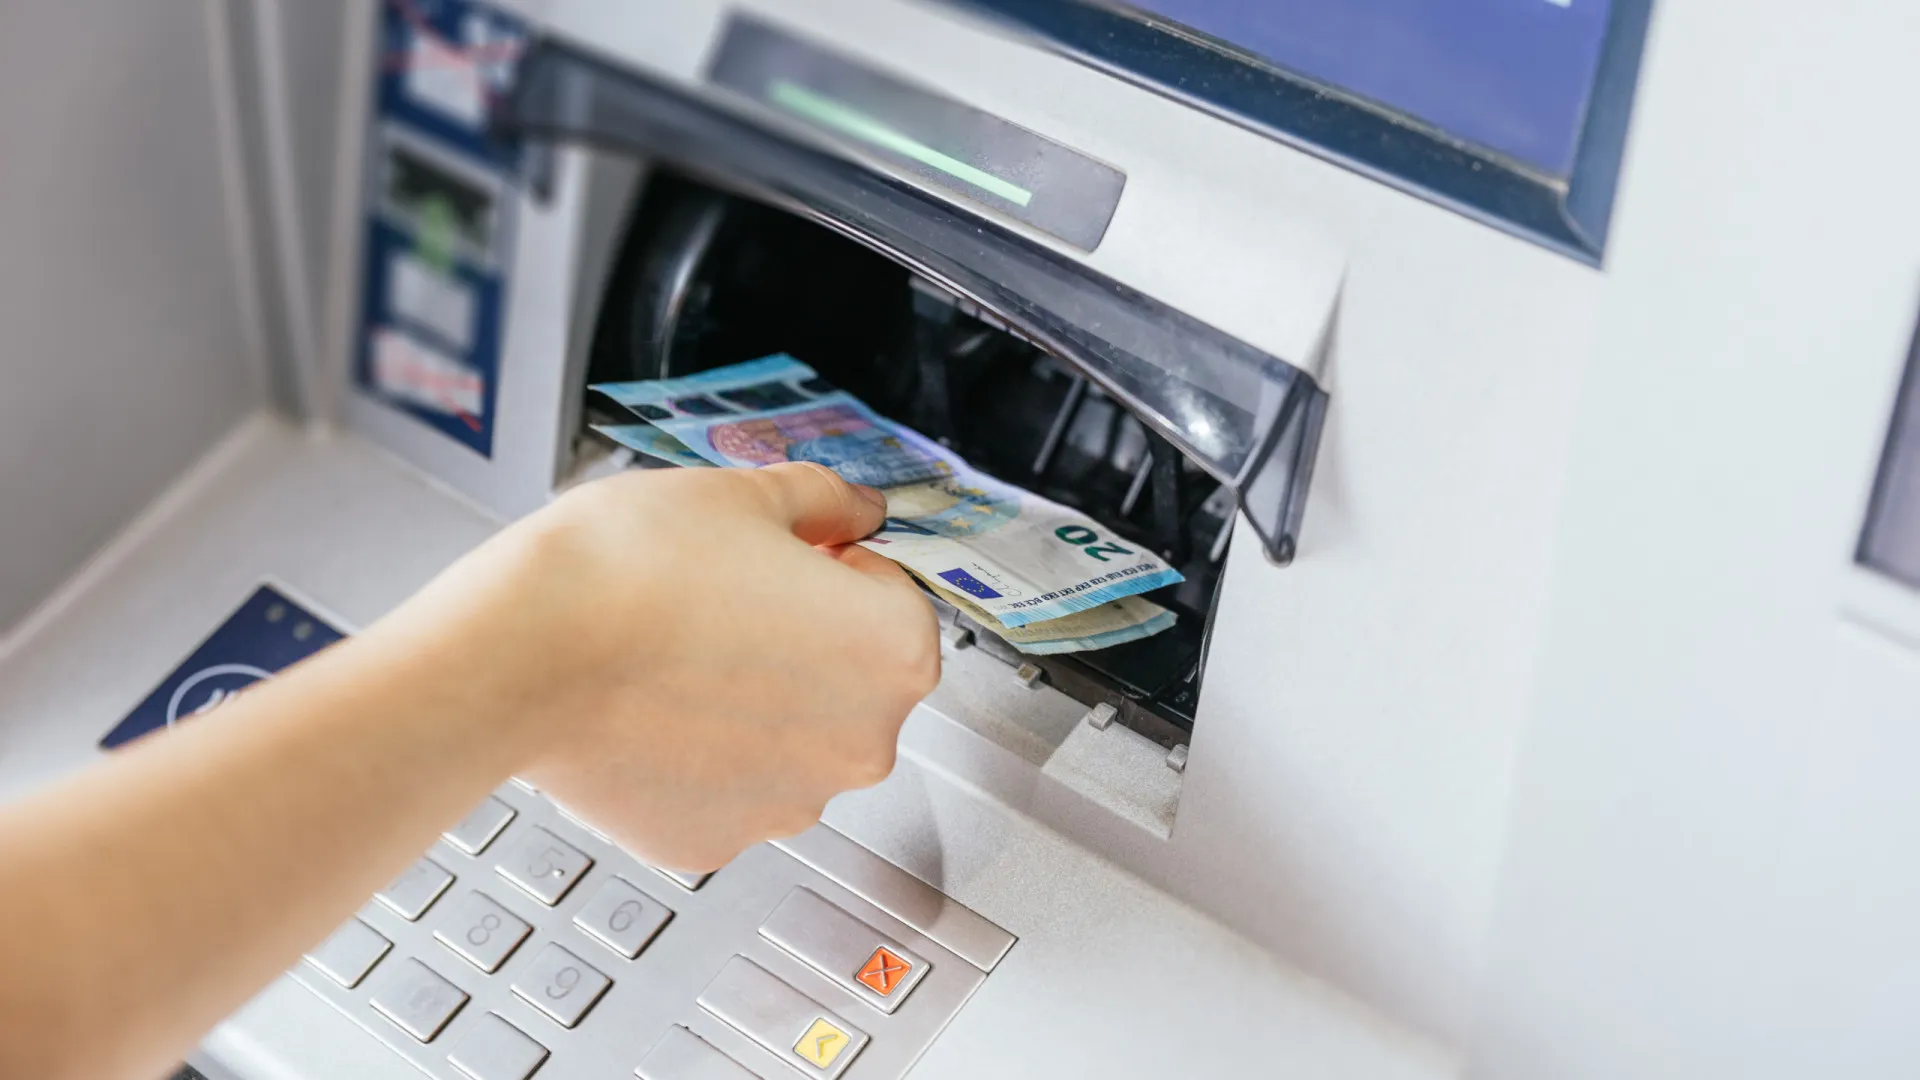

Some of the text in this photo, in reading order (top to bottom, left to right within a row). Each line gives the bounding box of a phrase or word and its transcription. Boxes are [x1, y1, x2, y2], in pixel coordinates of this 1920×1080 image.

[1053, 524, 1136, 562] 20
[1040, 591, 1060, 602] EKB
[1058, 586, 1076, 597] EKT
[1074, 581, 1093, 592] EKP
[528, 847, 565, 879] 5
[466, 913, 502, 946] 8
[608, 899, 643, 933] 6
[545, 966, 581, 1000] 9
